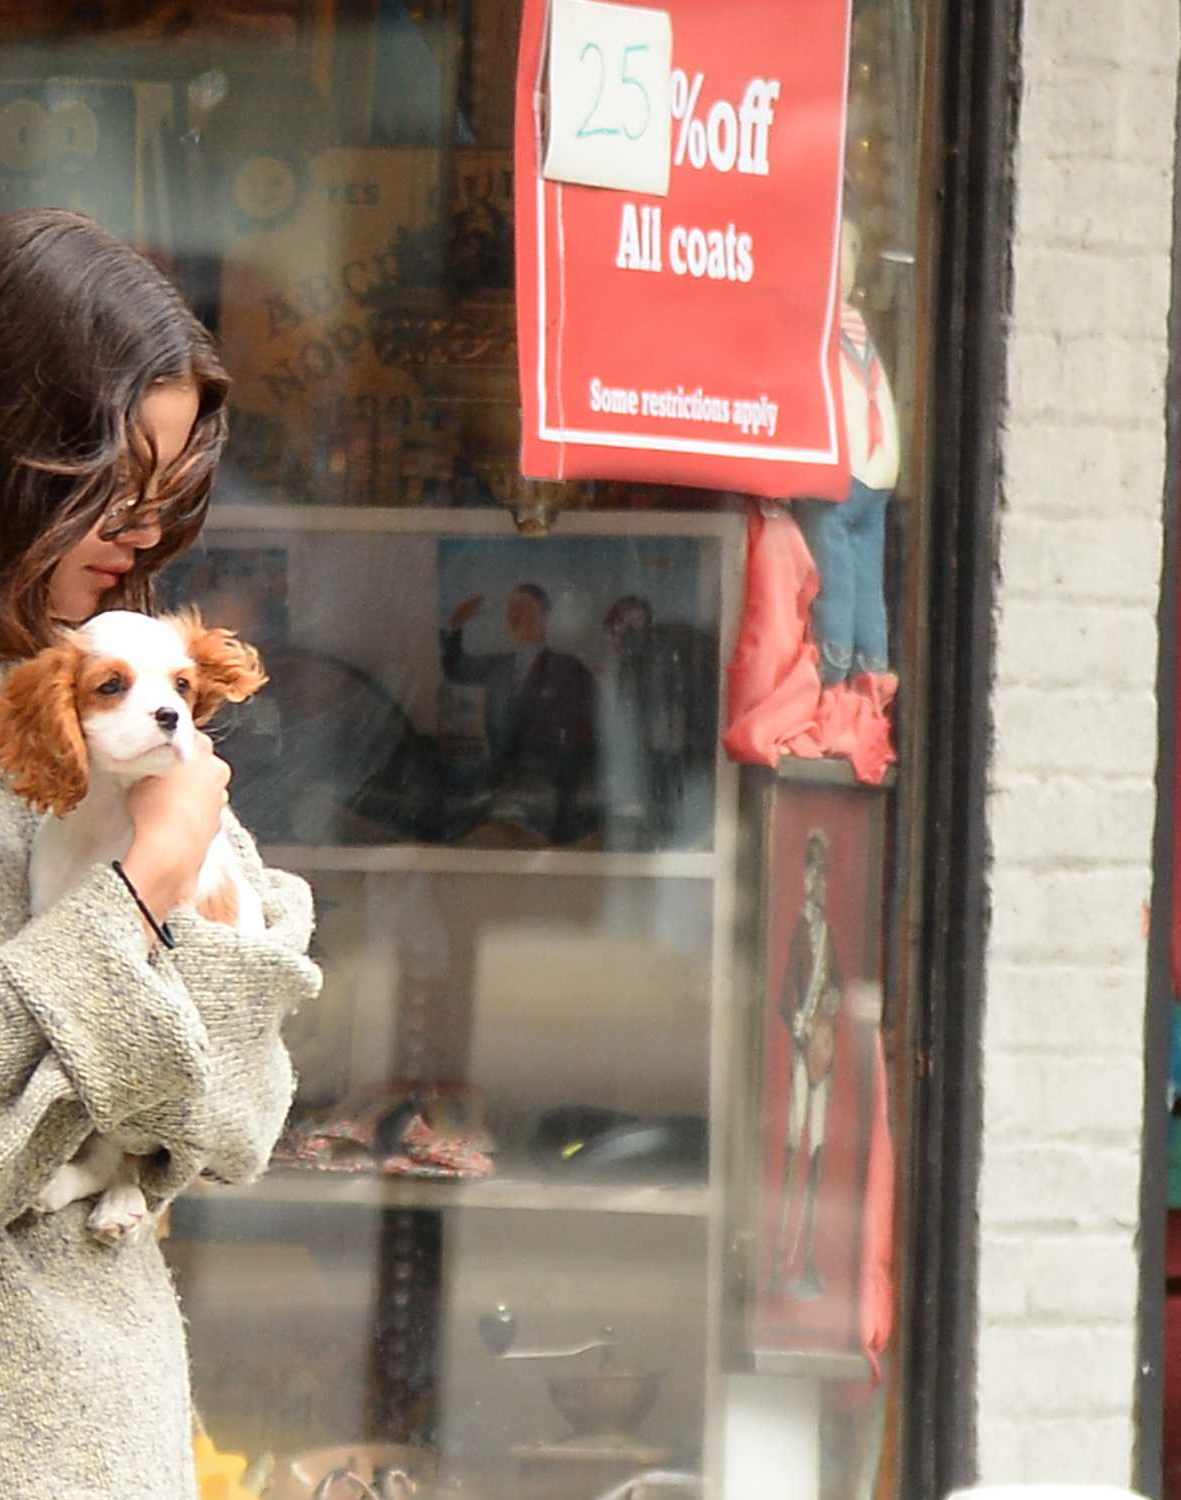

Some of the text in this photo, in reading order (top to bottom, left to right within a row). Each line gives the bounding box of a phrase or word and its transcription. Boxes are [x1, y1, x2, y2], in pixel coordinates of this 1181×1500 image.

[576, 42, 650, 140] 25
[616, 203, 754, 283] All coats
[590, 377, 779, 437] Some restrictions apply
